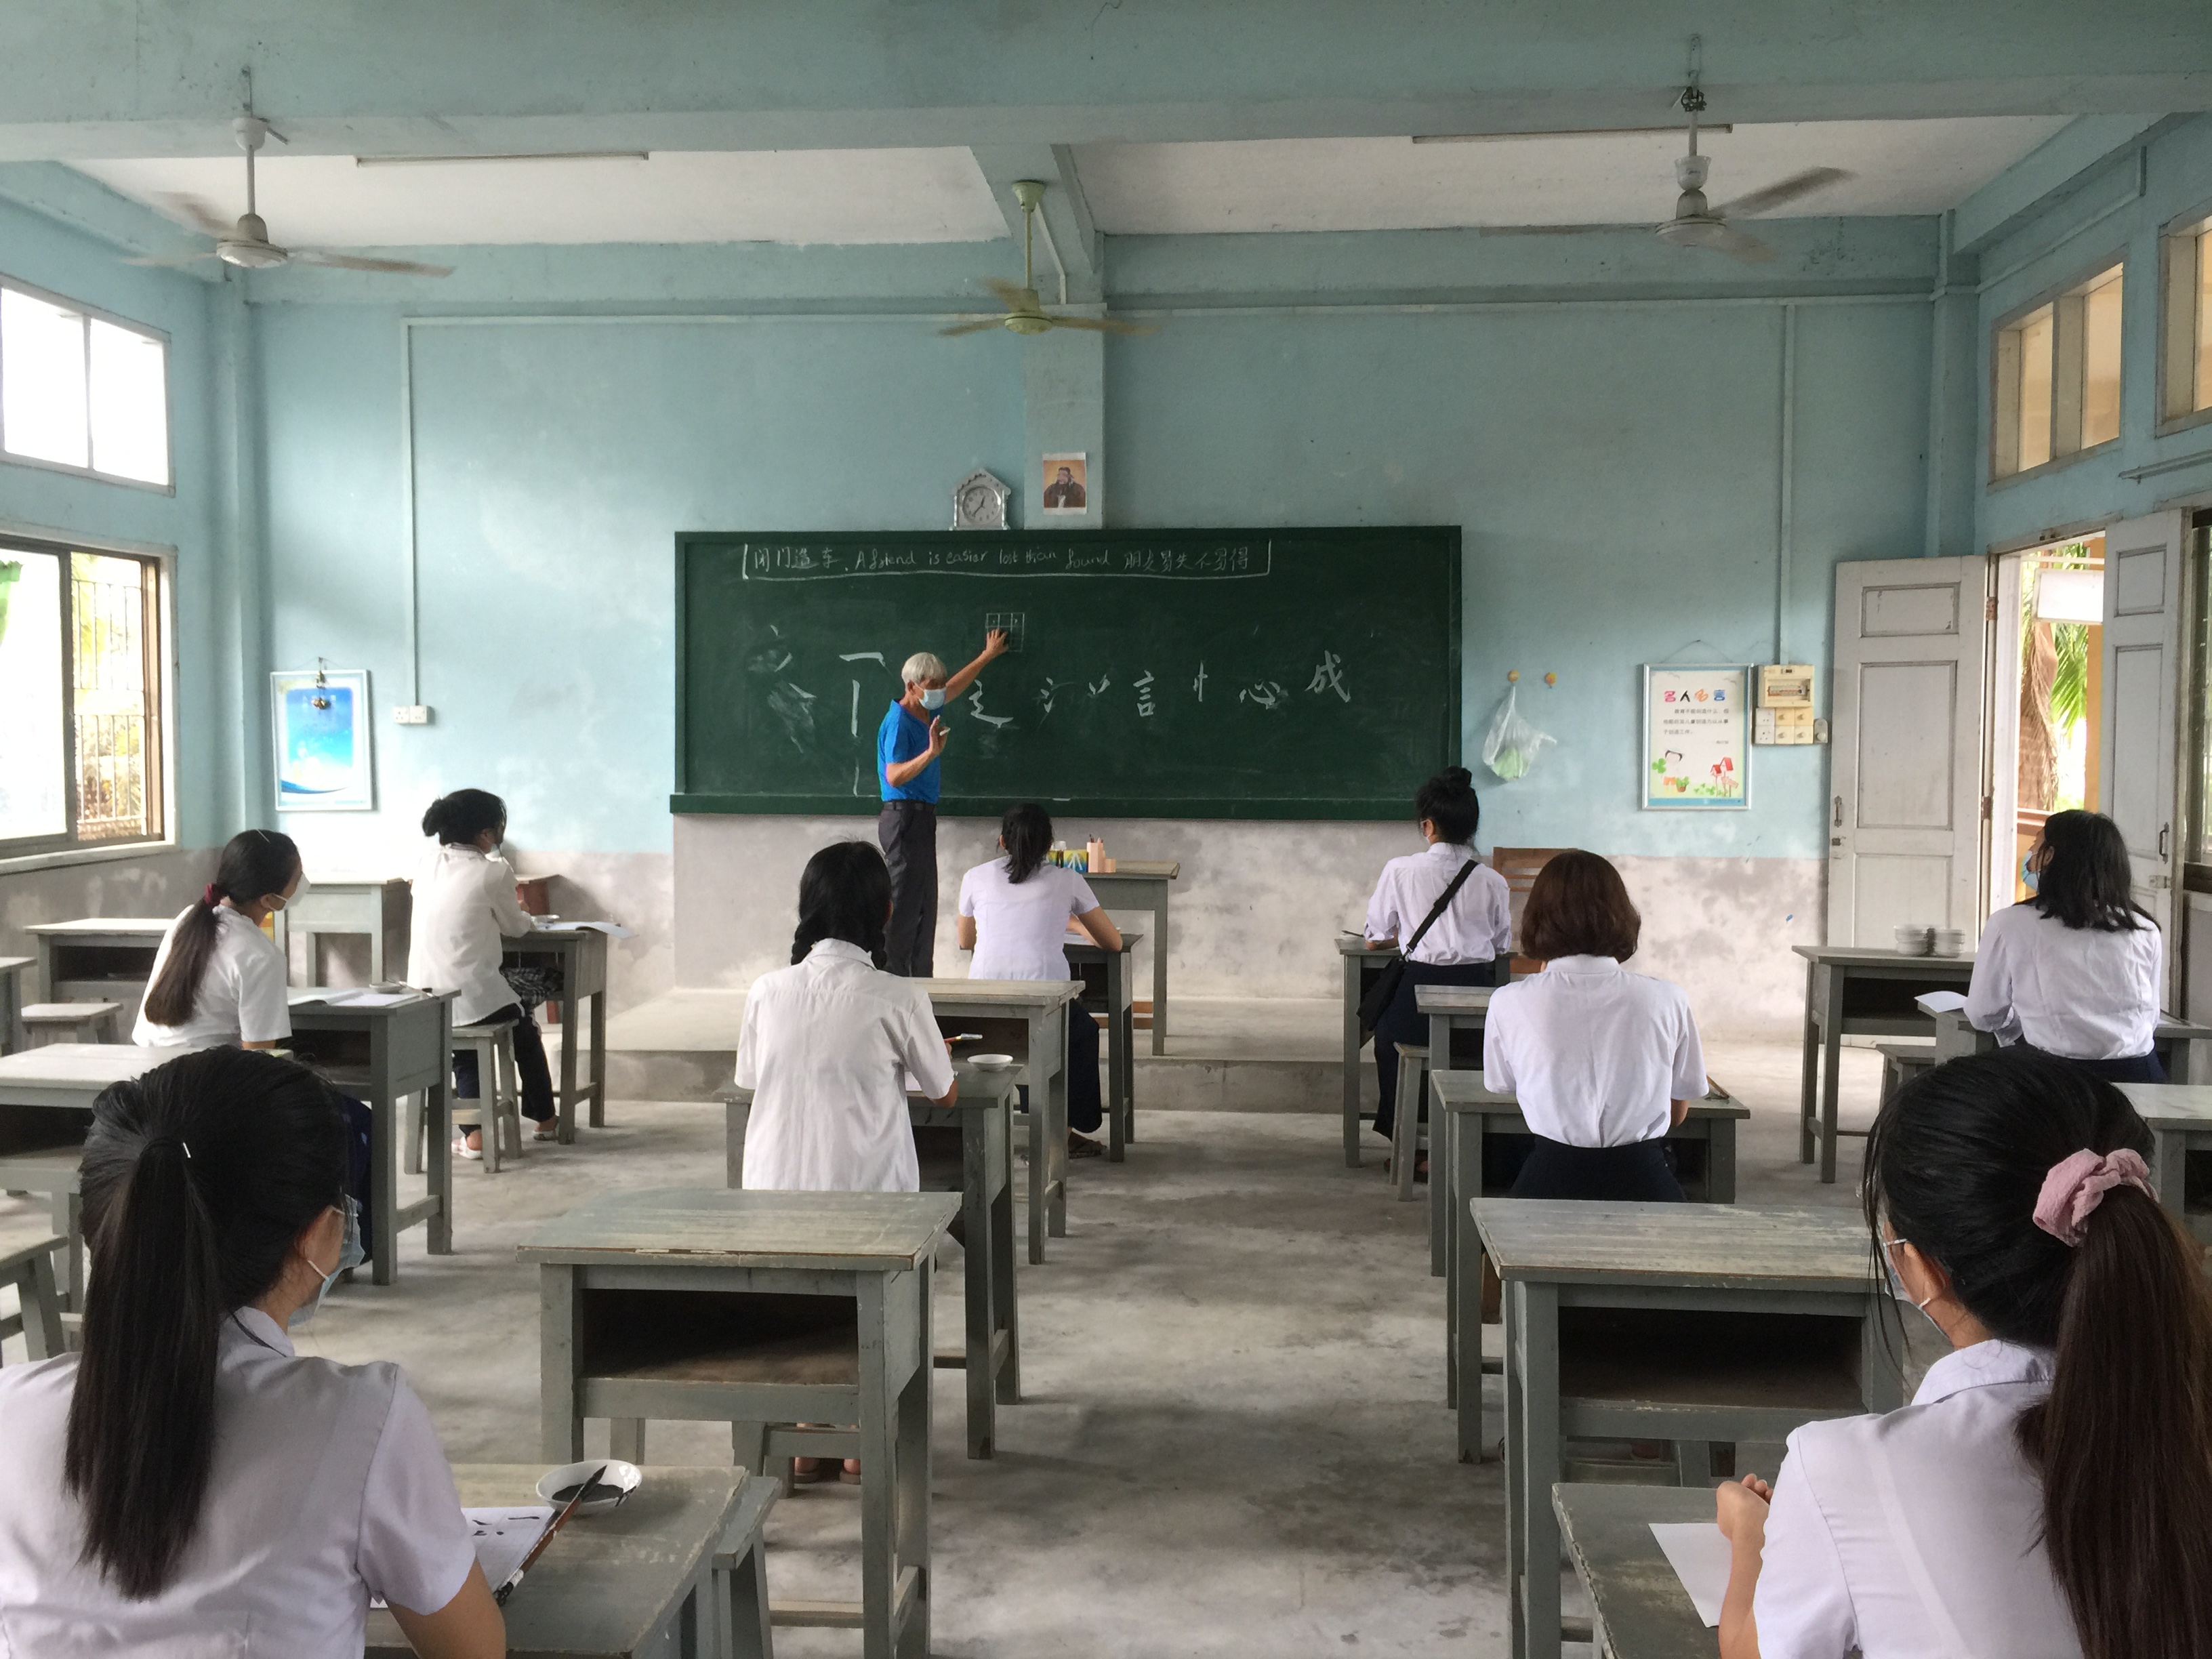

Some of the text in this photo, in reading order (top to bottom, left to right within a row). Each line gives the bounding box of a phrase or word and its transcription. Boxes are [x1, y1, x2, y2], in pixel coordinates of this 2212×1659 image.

[855, 550, 866, 570] A
[869, 548, 916, 570] friend
[929, 550, 941, 565] is
[946, 550, 989, 565] easier
[999, 548, 1019, 565] lost
[1065, 548, 1111, 569] found
[1664, 688, 1726, 703] 名人名言
